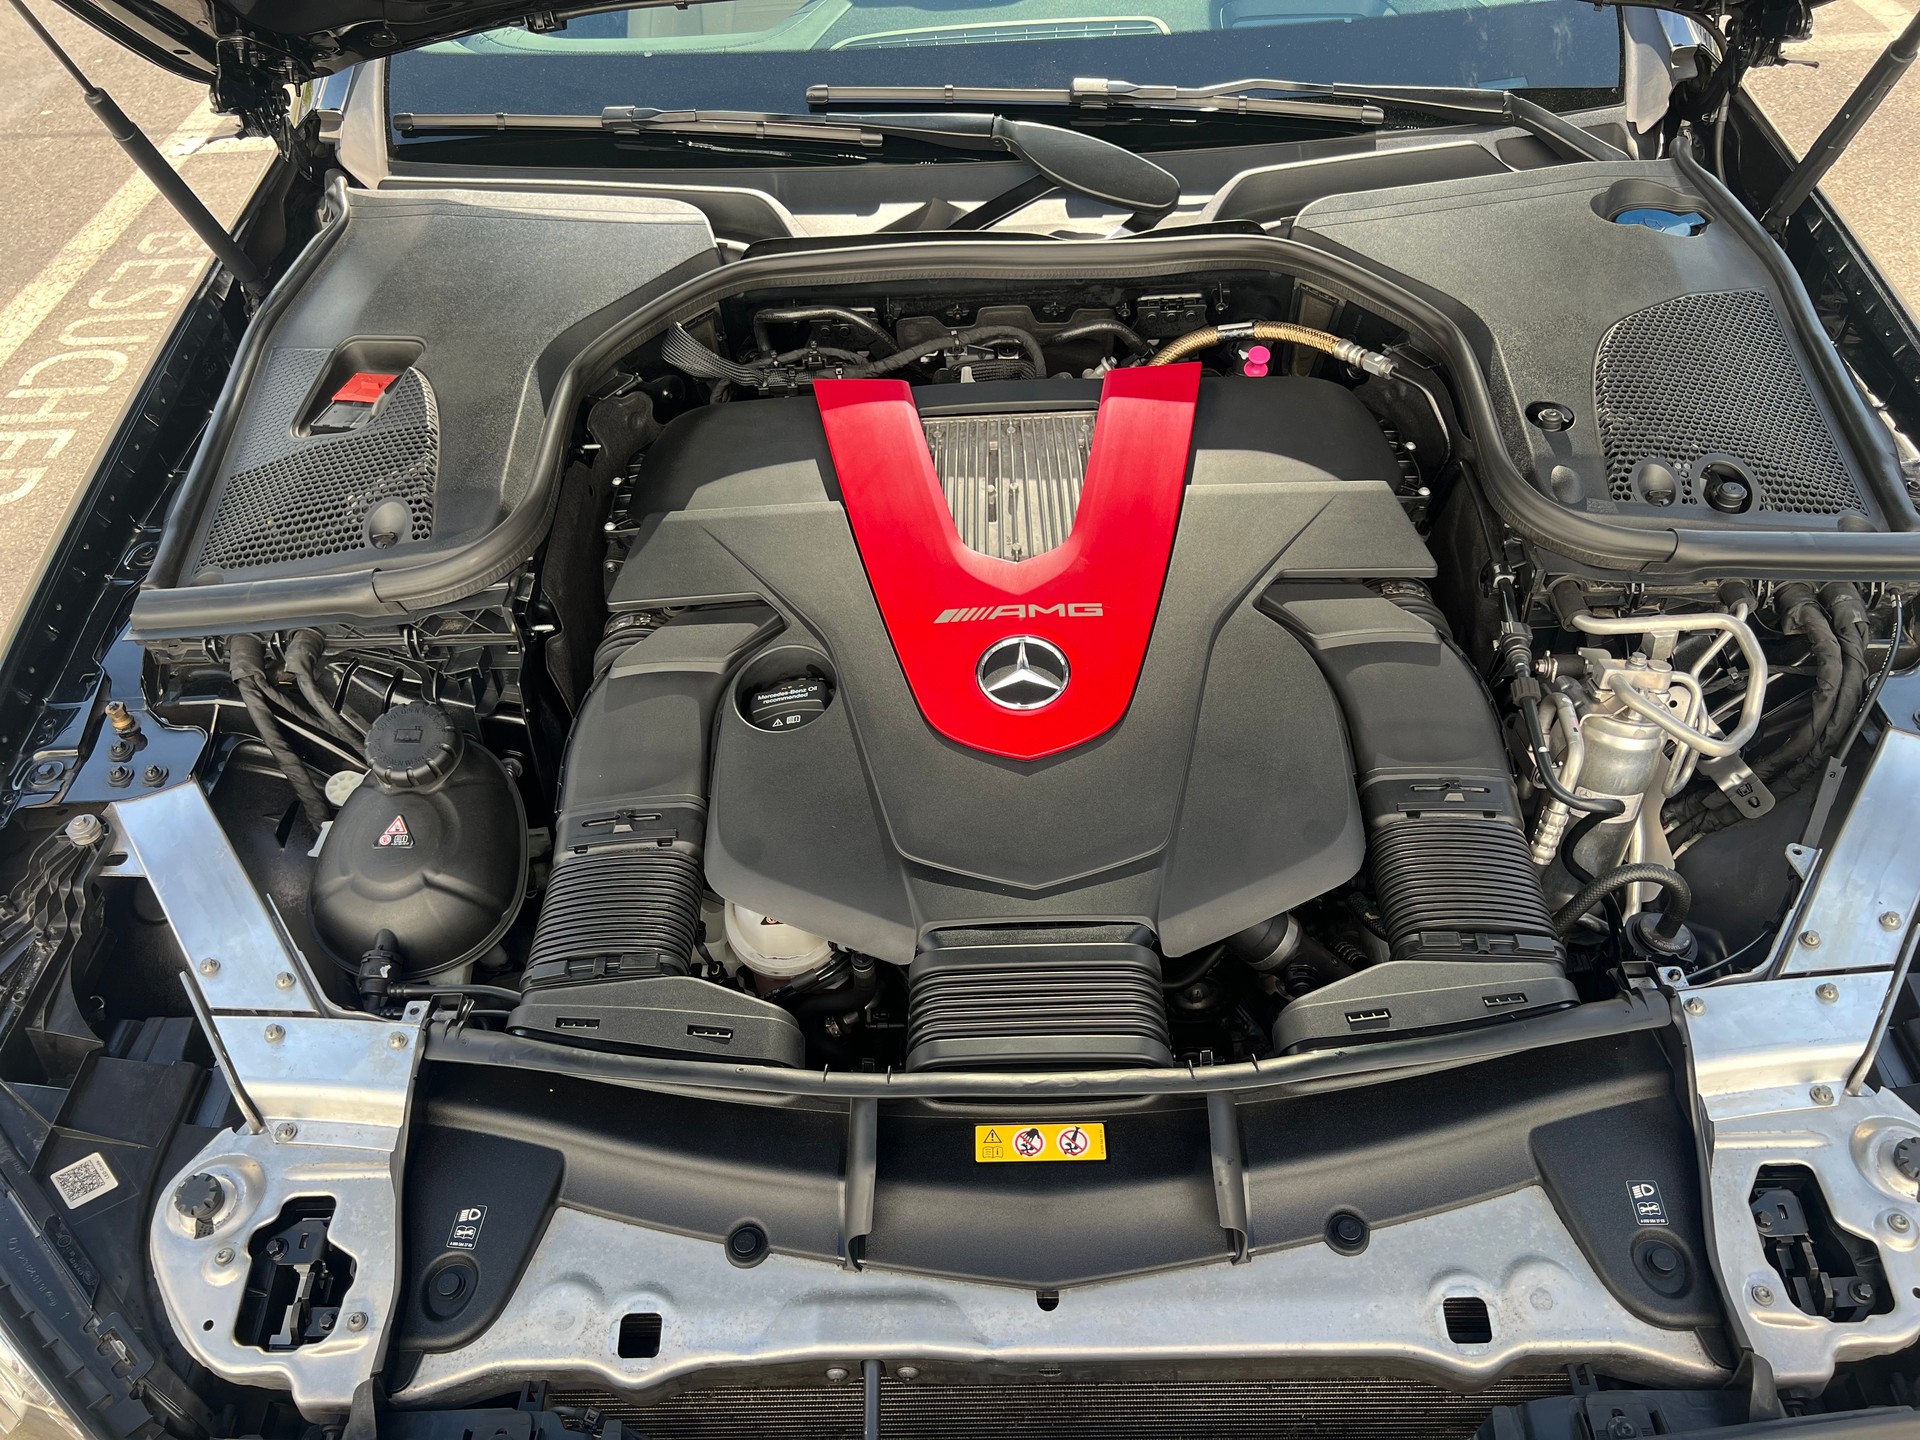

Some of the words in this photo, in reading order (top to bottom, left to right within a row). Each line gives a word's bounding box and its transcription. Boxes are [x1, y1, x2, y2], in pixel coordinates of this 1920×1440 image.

[987, 603, 1104, 620] AMG
[757, 688, 807, 700] Mercedes-Benz
[763, 692, 809, 704] recommended
